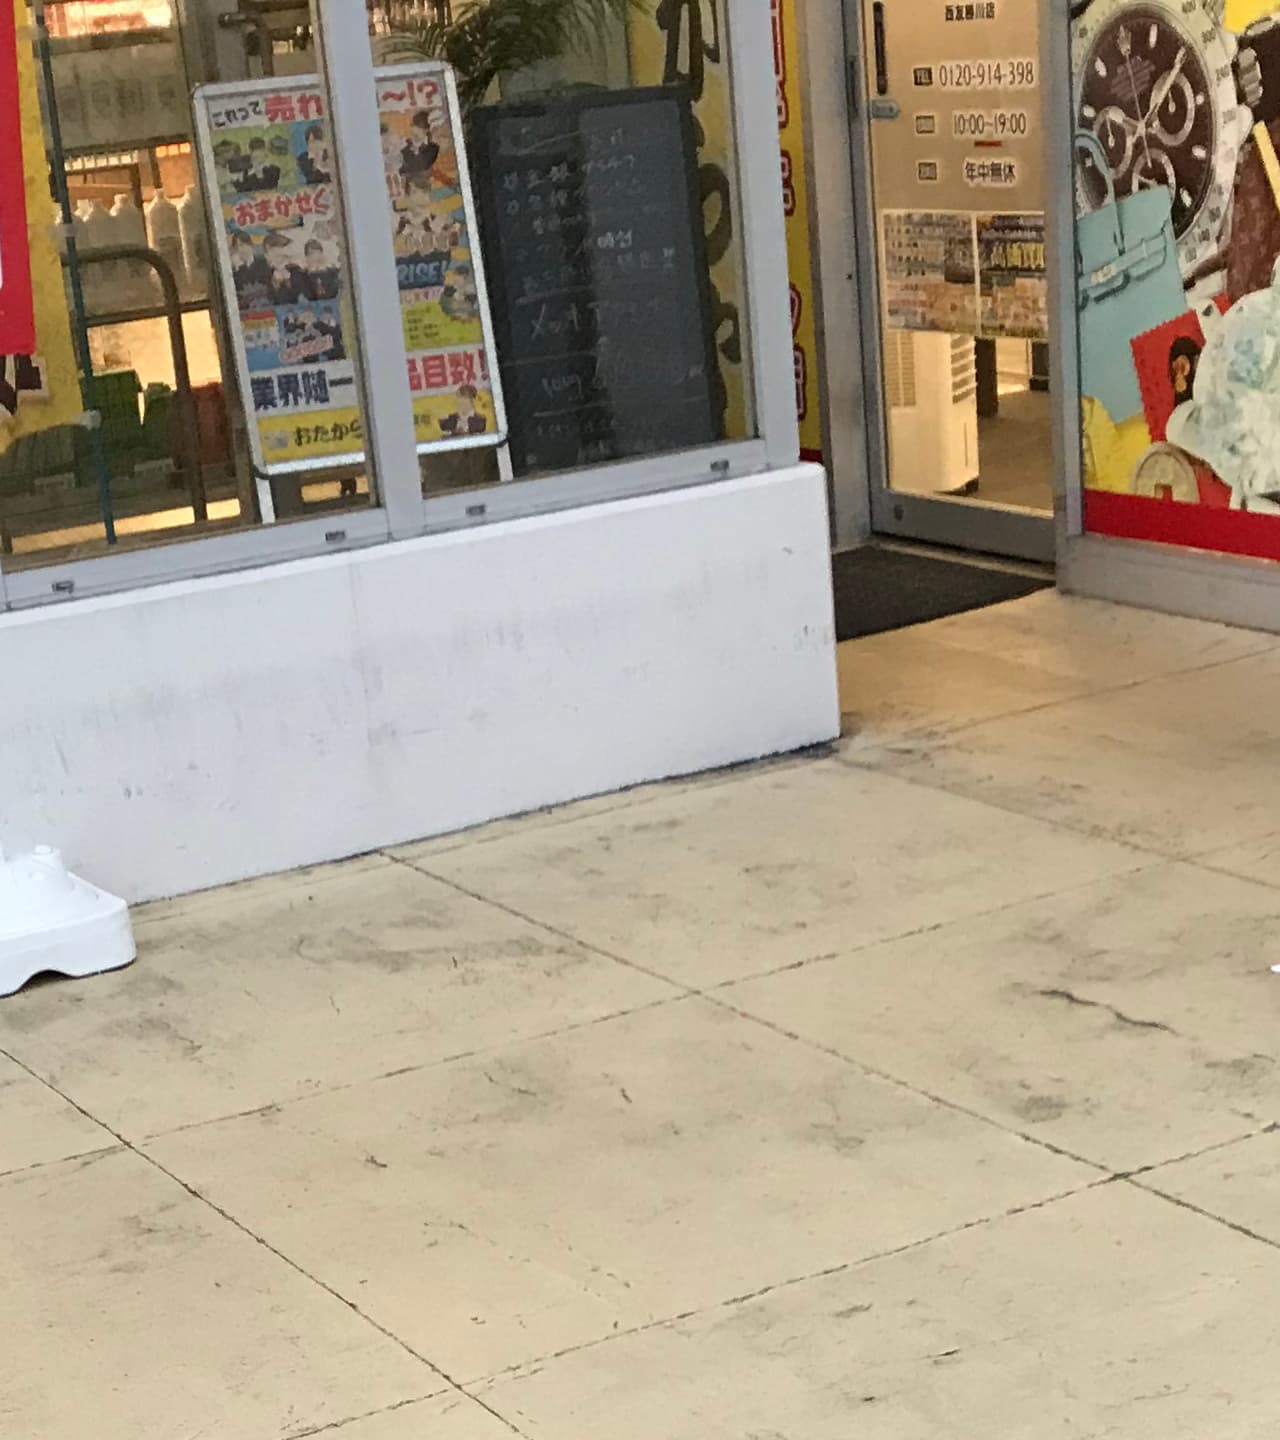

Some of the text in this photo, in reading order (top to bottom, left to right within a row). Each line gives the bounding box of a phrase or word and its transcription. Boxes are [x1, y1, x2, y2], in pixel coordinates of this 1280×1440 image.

[939, 61, 1035, 87] 0120-914-398
[965, 161, 1016, 184] 年中無休
